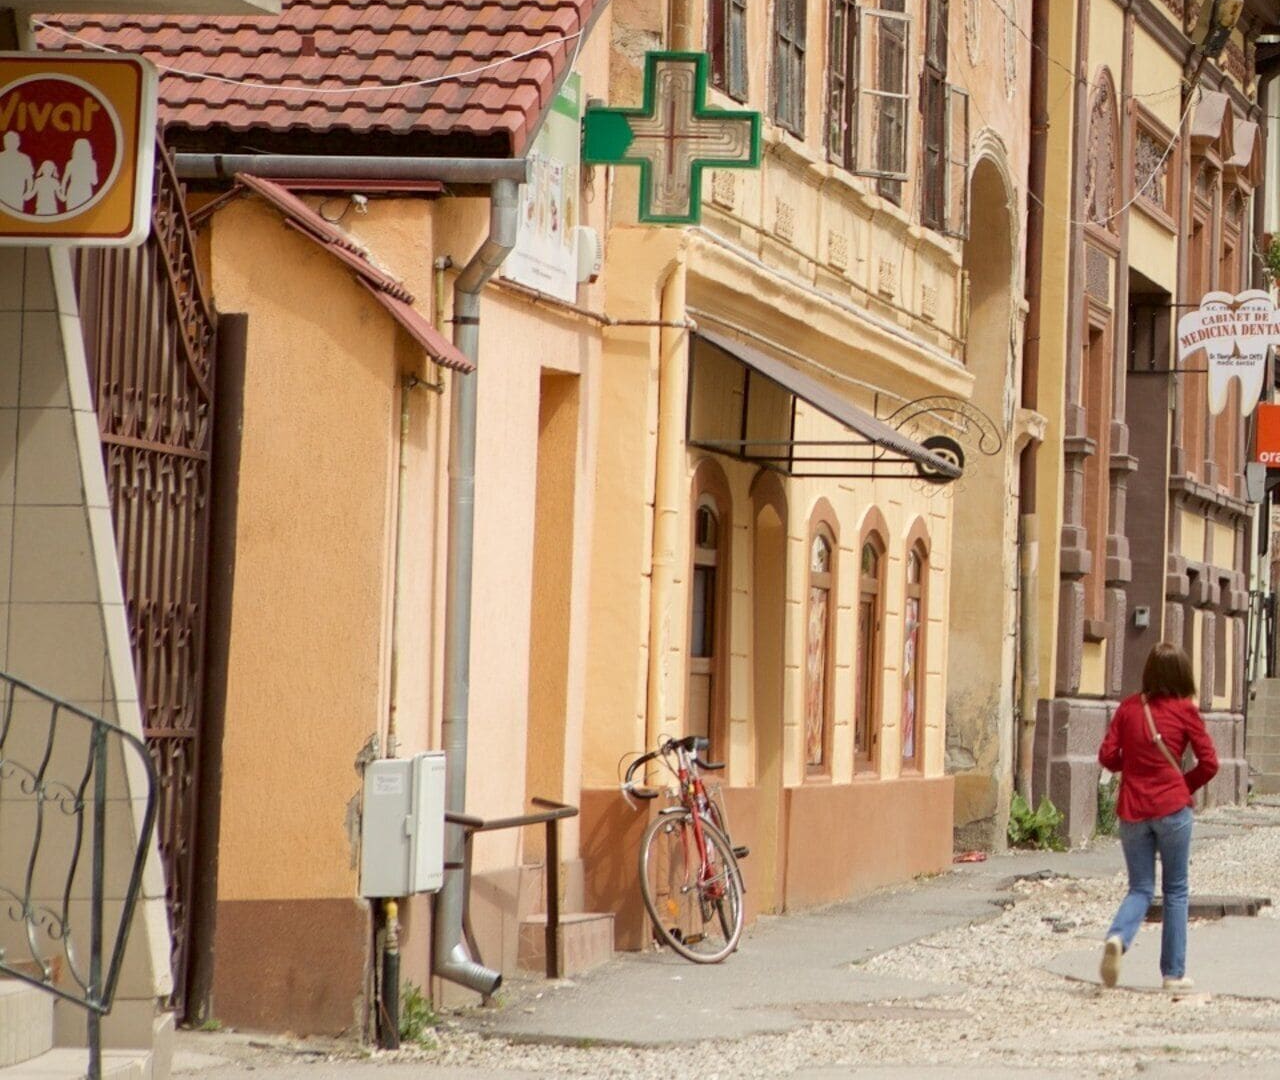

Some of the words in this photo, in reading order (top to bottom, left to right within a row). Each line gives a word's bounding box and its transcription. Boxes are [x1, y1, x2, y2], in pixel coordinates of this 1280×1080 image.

[1201, 313, 1250, 326] CABINET
[1255, 313, 1269, 322] DE
[1180, 323, 1237, 348] MEDICINA
